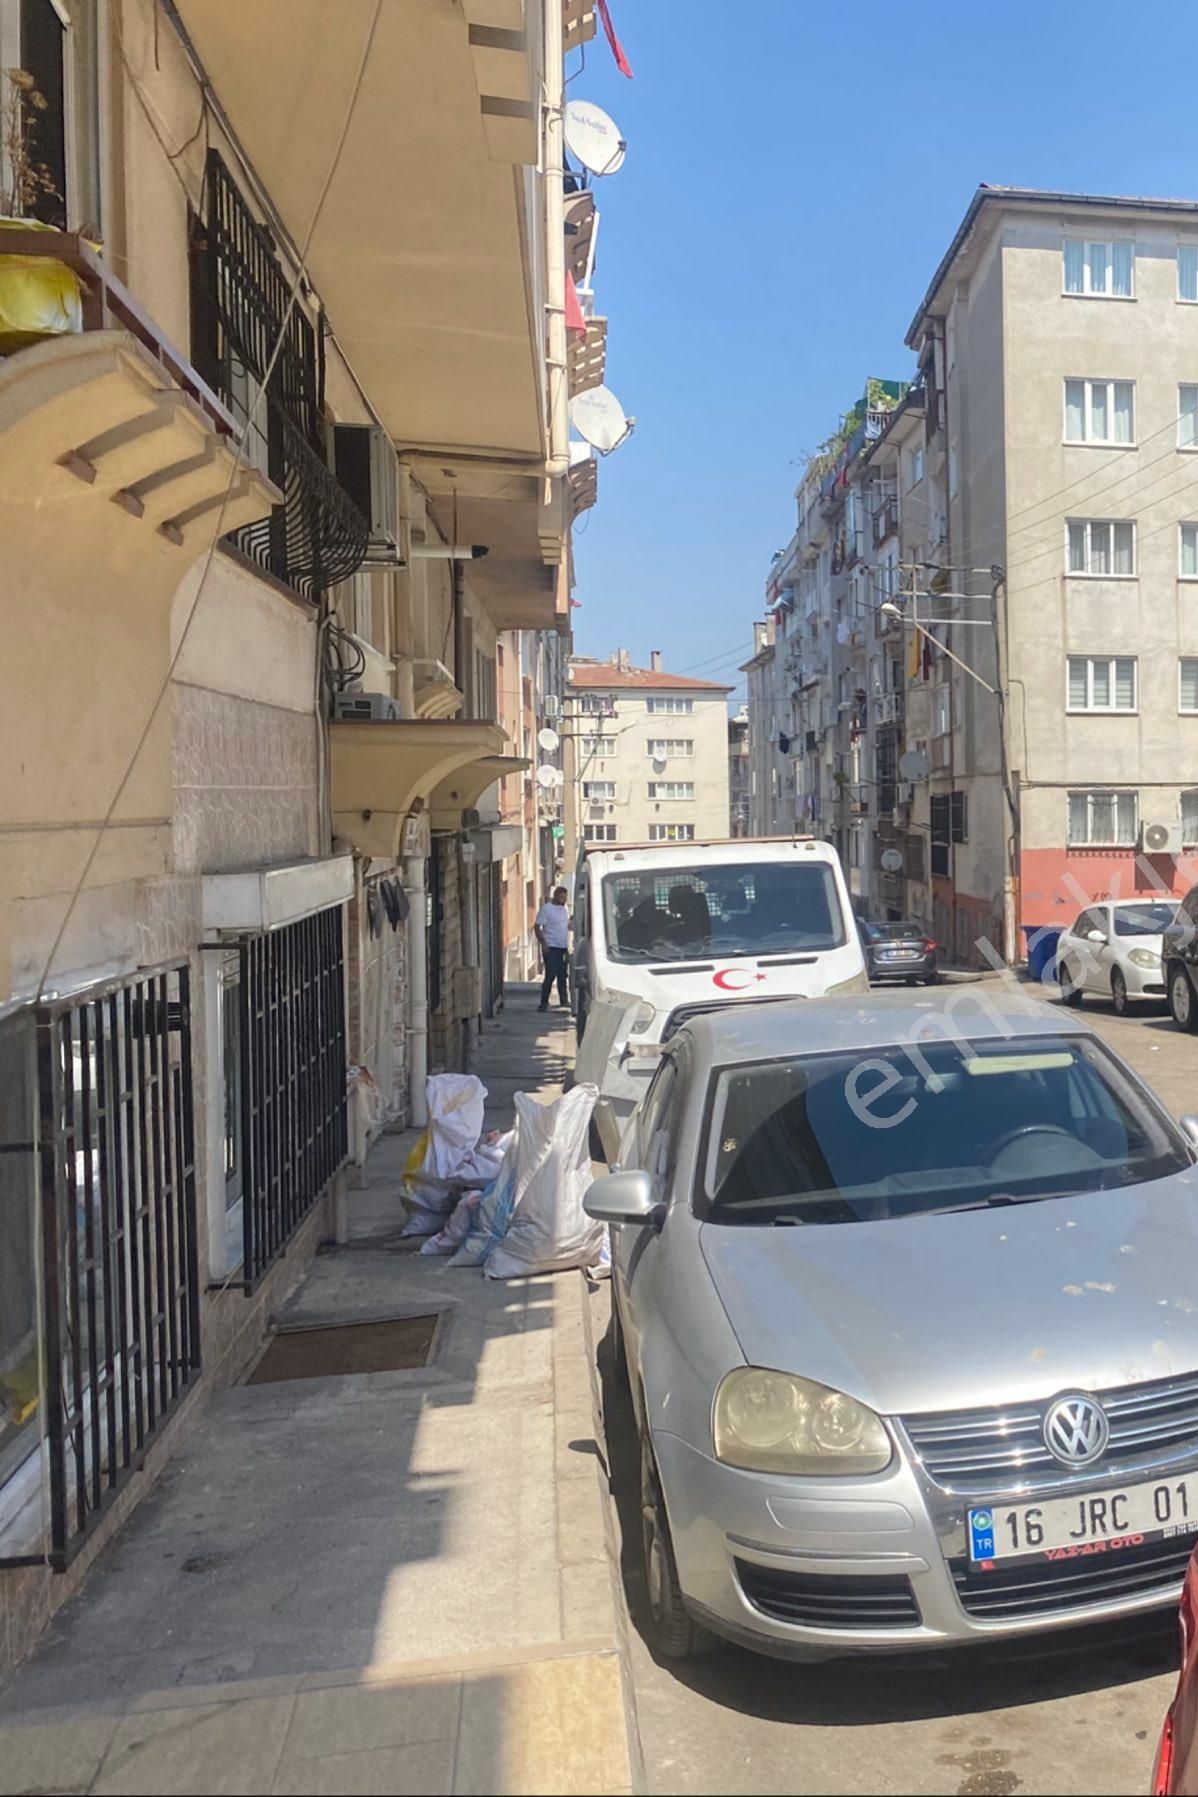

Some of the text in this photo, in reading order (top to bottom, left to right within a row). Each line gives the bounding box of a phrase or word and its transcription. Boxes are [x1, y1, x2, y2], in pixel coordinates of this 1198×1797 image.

[1005, 1507, 1044, 1549] 16
[1070, 1493, 1129, 1538] JRC
[1154, 1481, 1188, 1523] 01
[976, 1537, 993, 1551] TR
[1110, 1533, 1145, 1549] OTO
